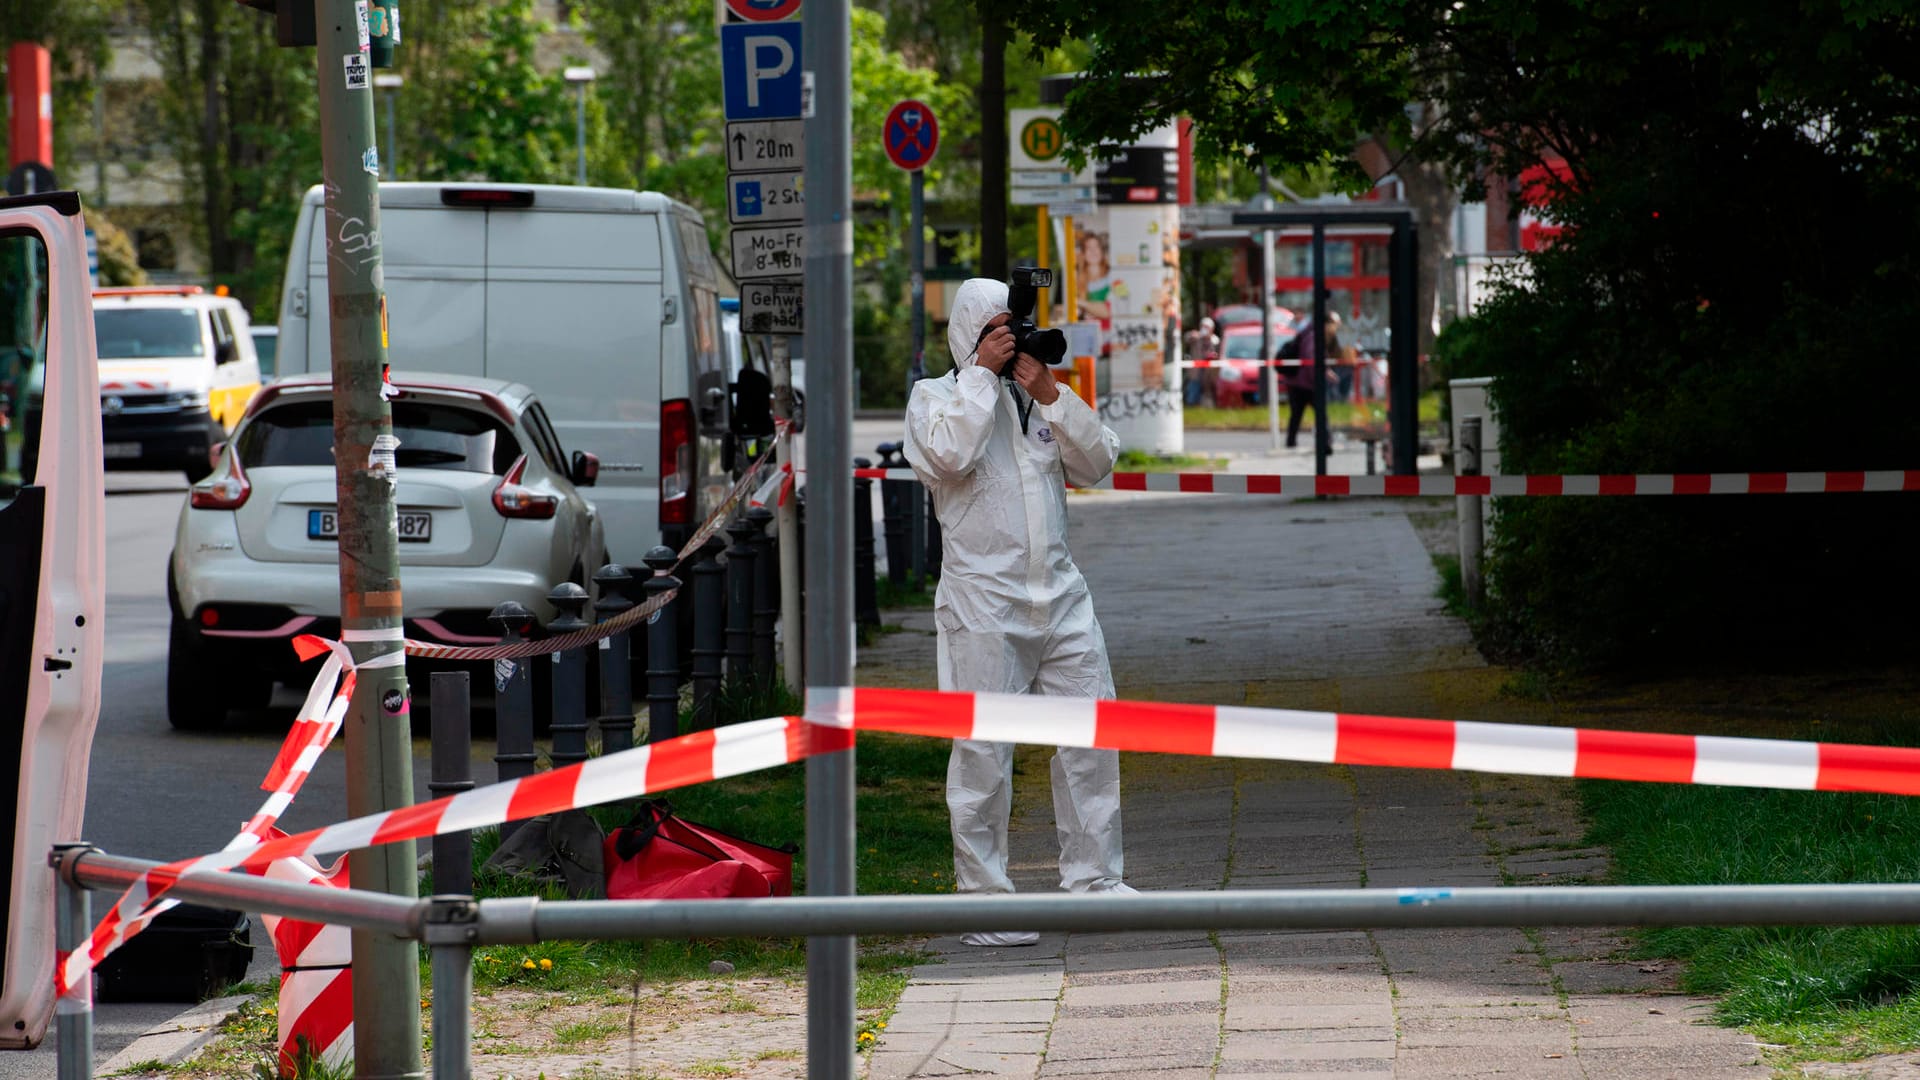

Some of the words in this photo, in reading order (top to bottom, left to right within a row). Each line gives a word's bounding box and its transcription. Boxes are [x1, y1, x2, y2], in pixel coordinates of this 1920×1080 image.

[744, 35, 794, 108] P
[1033, 127, 1052, 151] H
[767, 189, 777, 205] 2
[751, 233, 803, 251] Mo-Fr
[322, 514, 335, 533] B
[398, 515, 428, 535] 87
